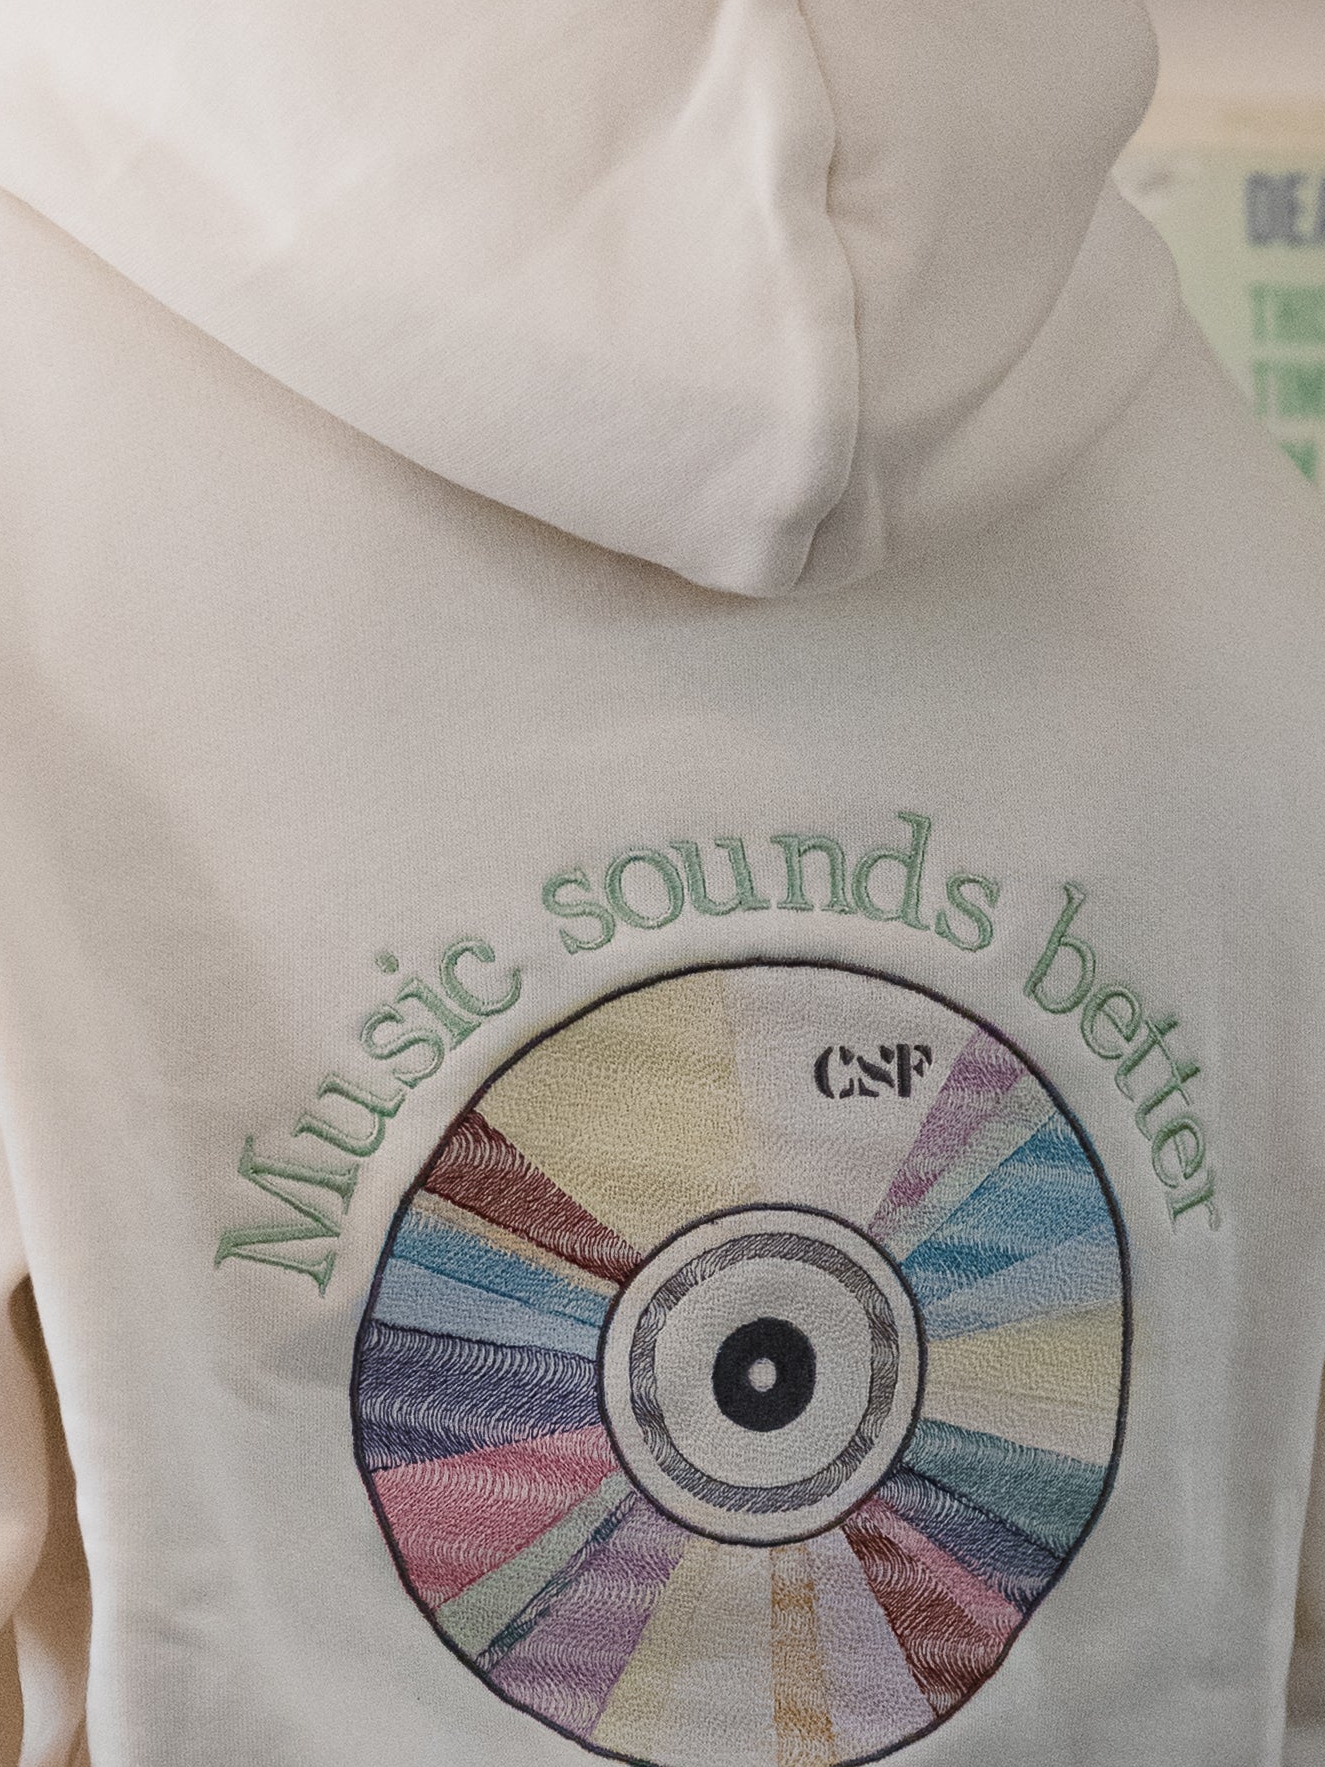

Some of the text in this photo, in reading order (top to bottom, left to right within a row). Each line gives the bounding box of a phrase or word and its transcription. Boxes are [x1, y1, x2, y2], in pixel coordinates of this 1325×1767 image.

[214, 810, 1222, 1299] Music sounds better
[813, 1042, 933, 1100] CSF
